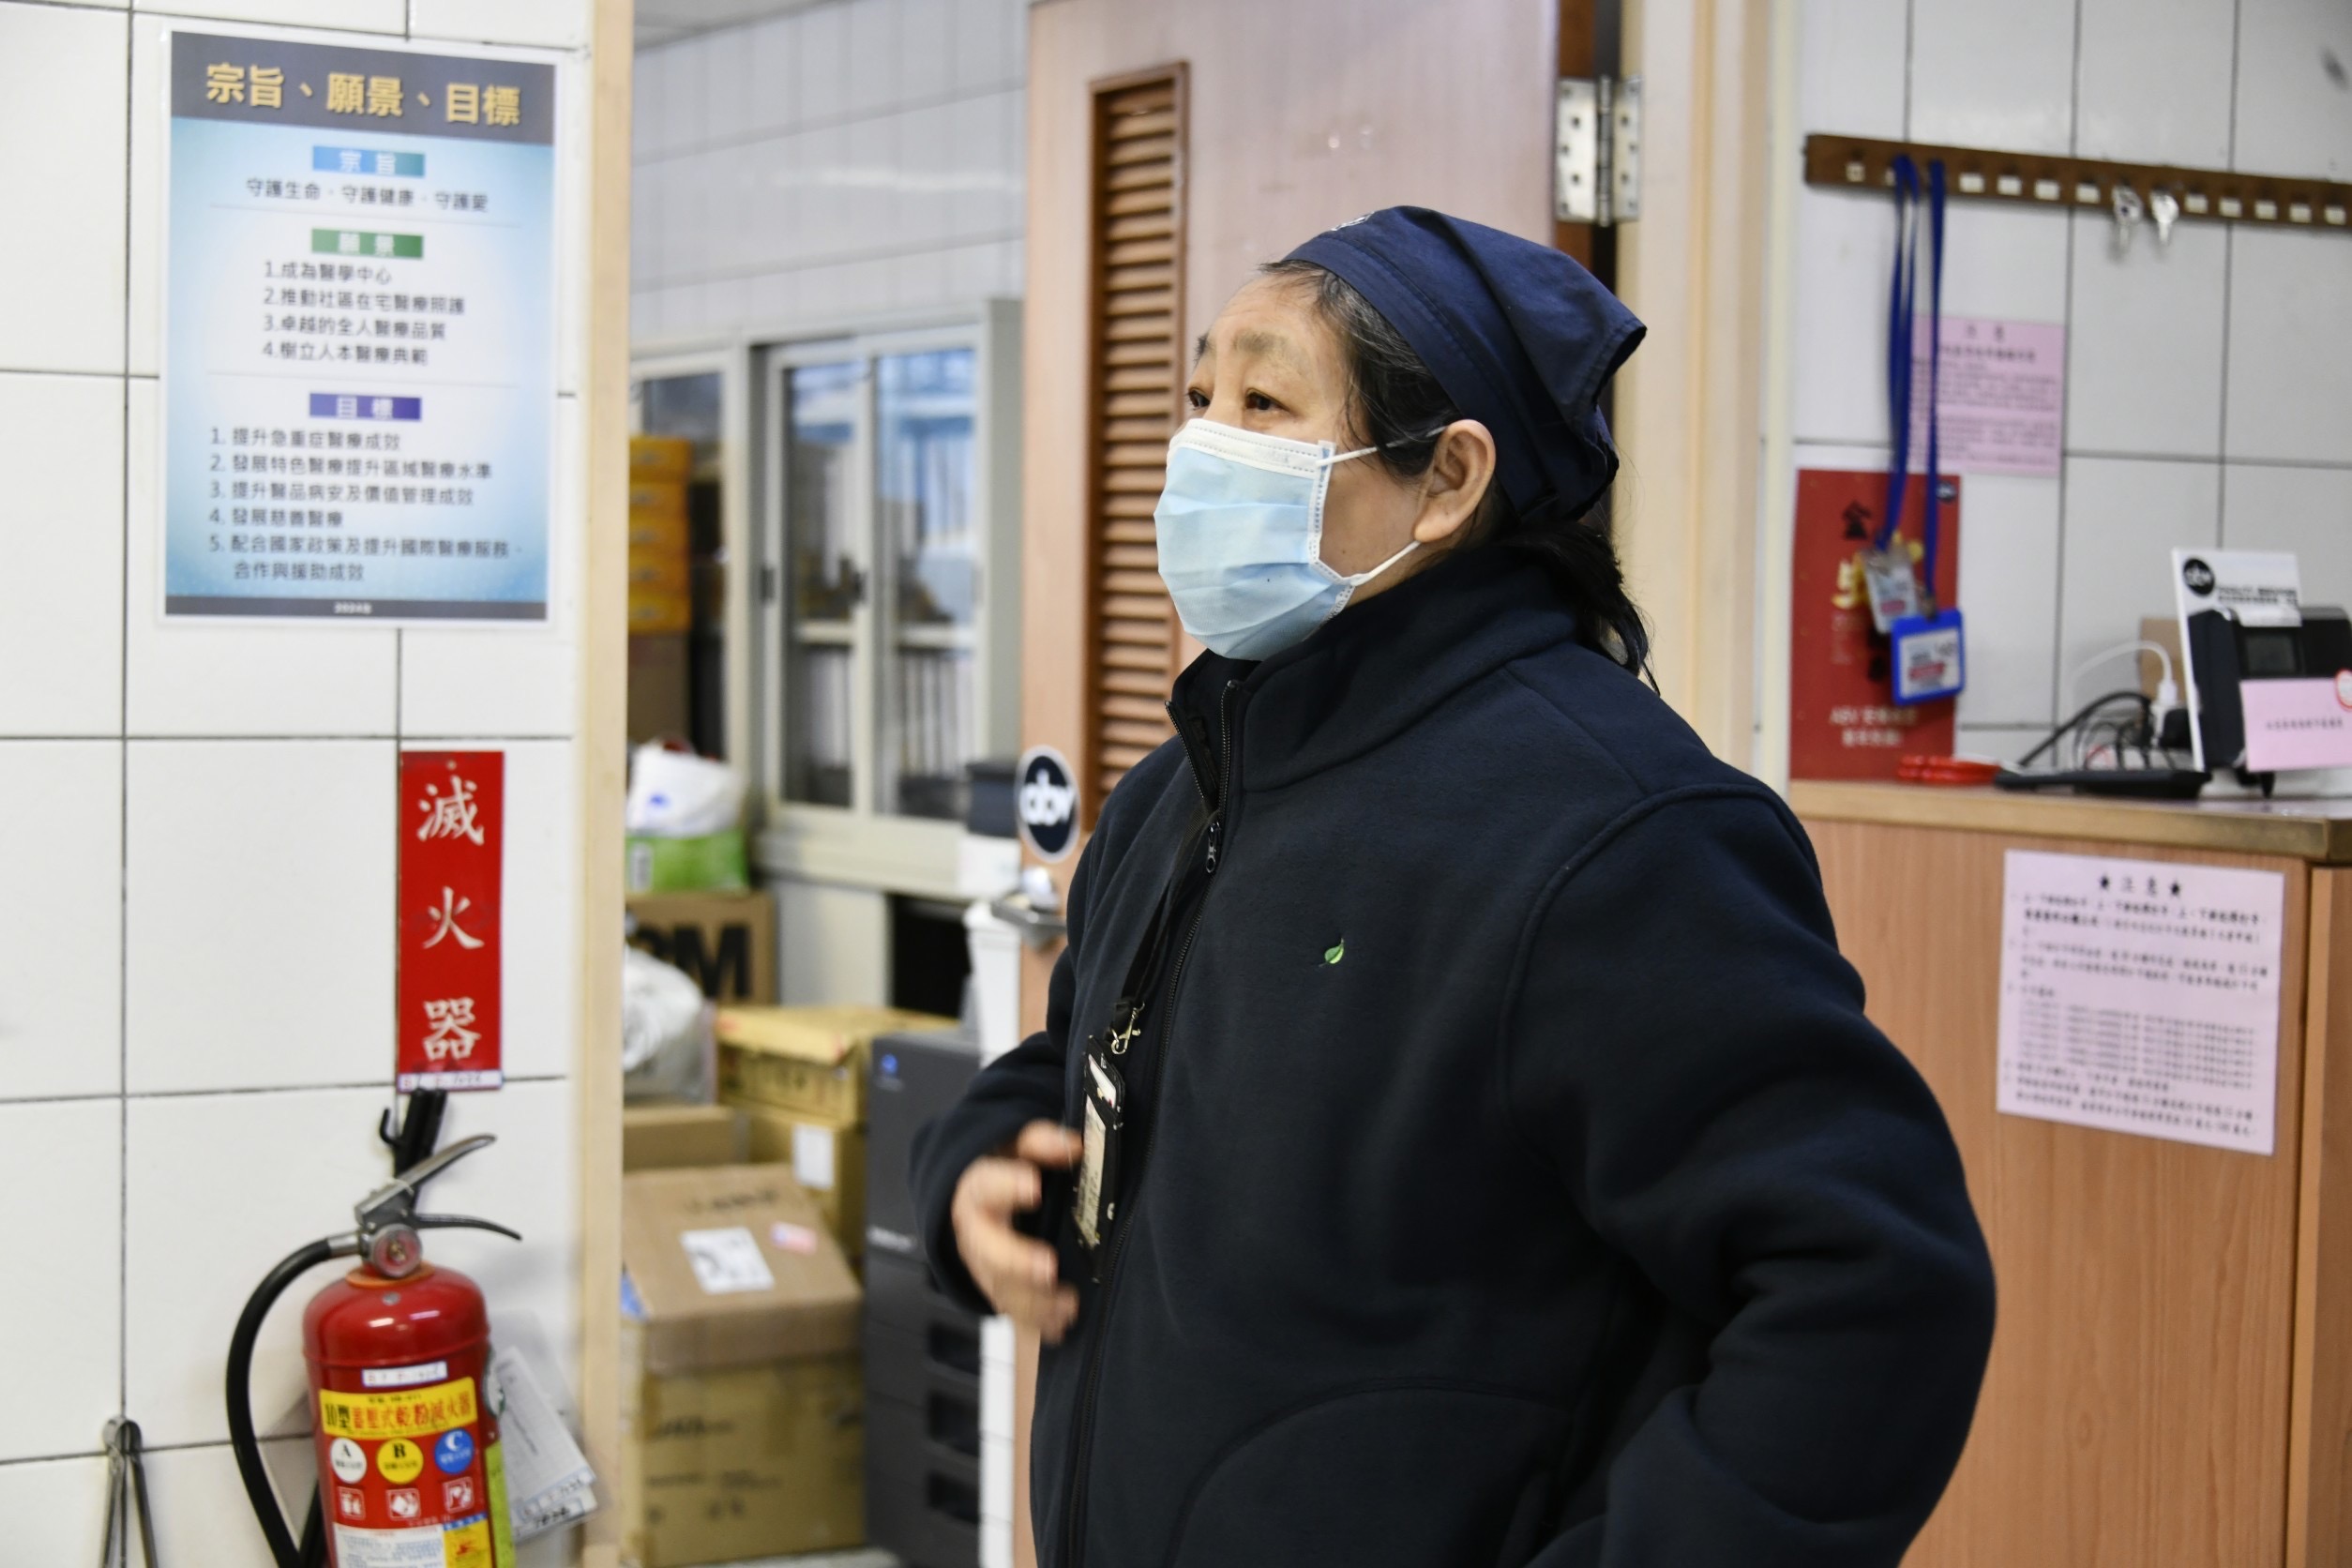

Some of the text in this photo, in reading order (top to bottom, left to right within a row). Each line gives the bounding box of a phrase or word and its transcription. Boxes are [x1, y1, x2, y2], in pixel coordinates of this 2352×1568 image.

[205, 62, 521, 127] 宗旨、願景、目標
[339, 151, 397, 175] 宗旨
[338, 232, 396, 258] 願景
[336, 396, 394, 420] 目標
[416, 775, 485, 1061] 滅火器
[394, 1442, 407, 1459] B
[445, 1430, 463, 1452] C
